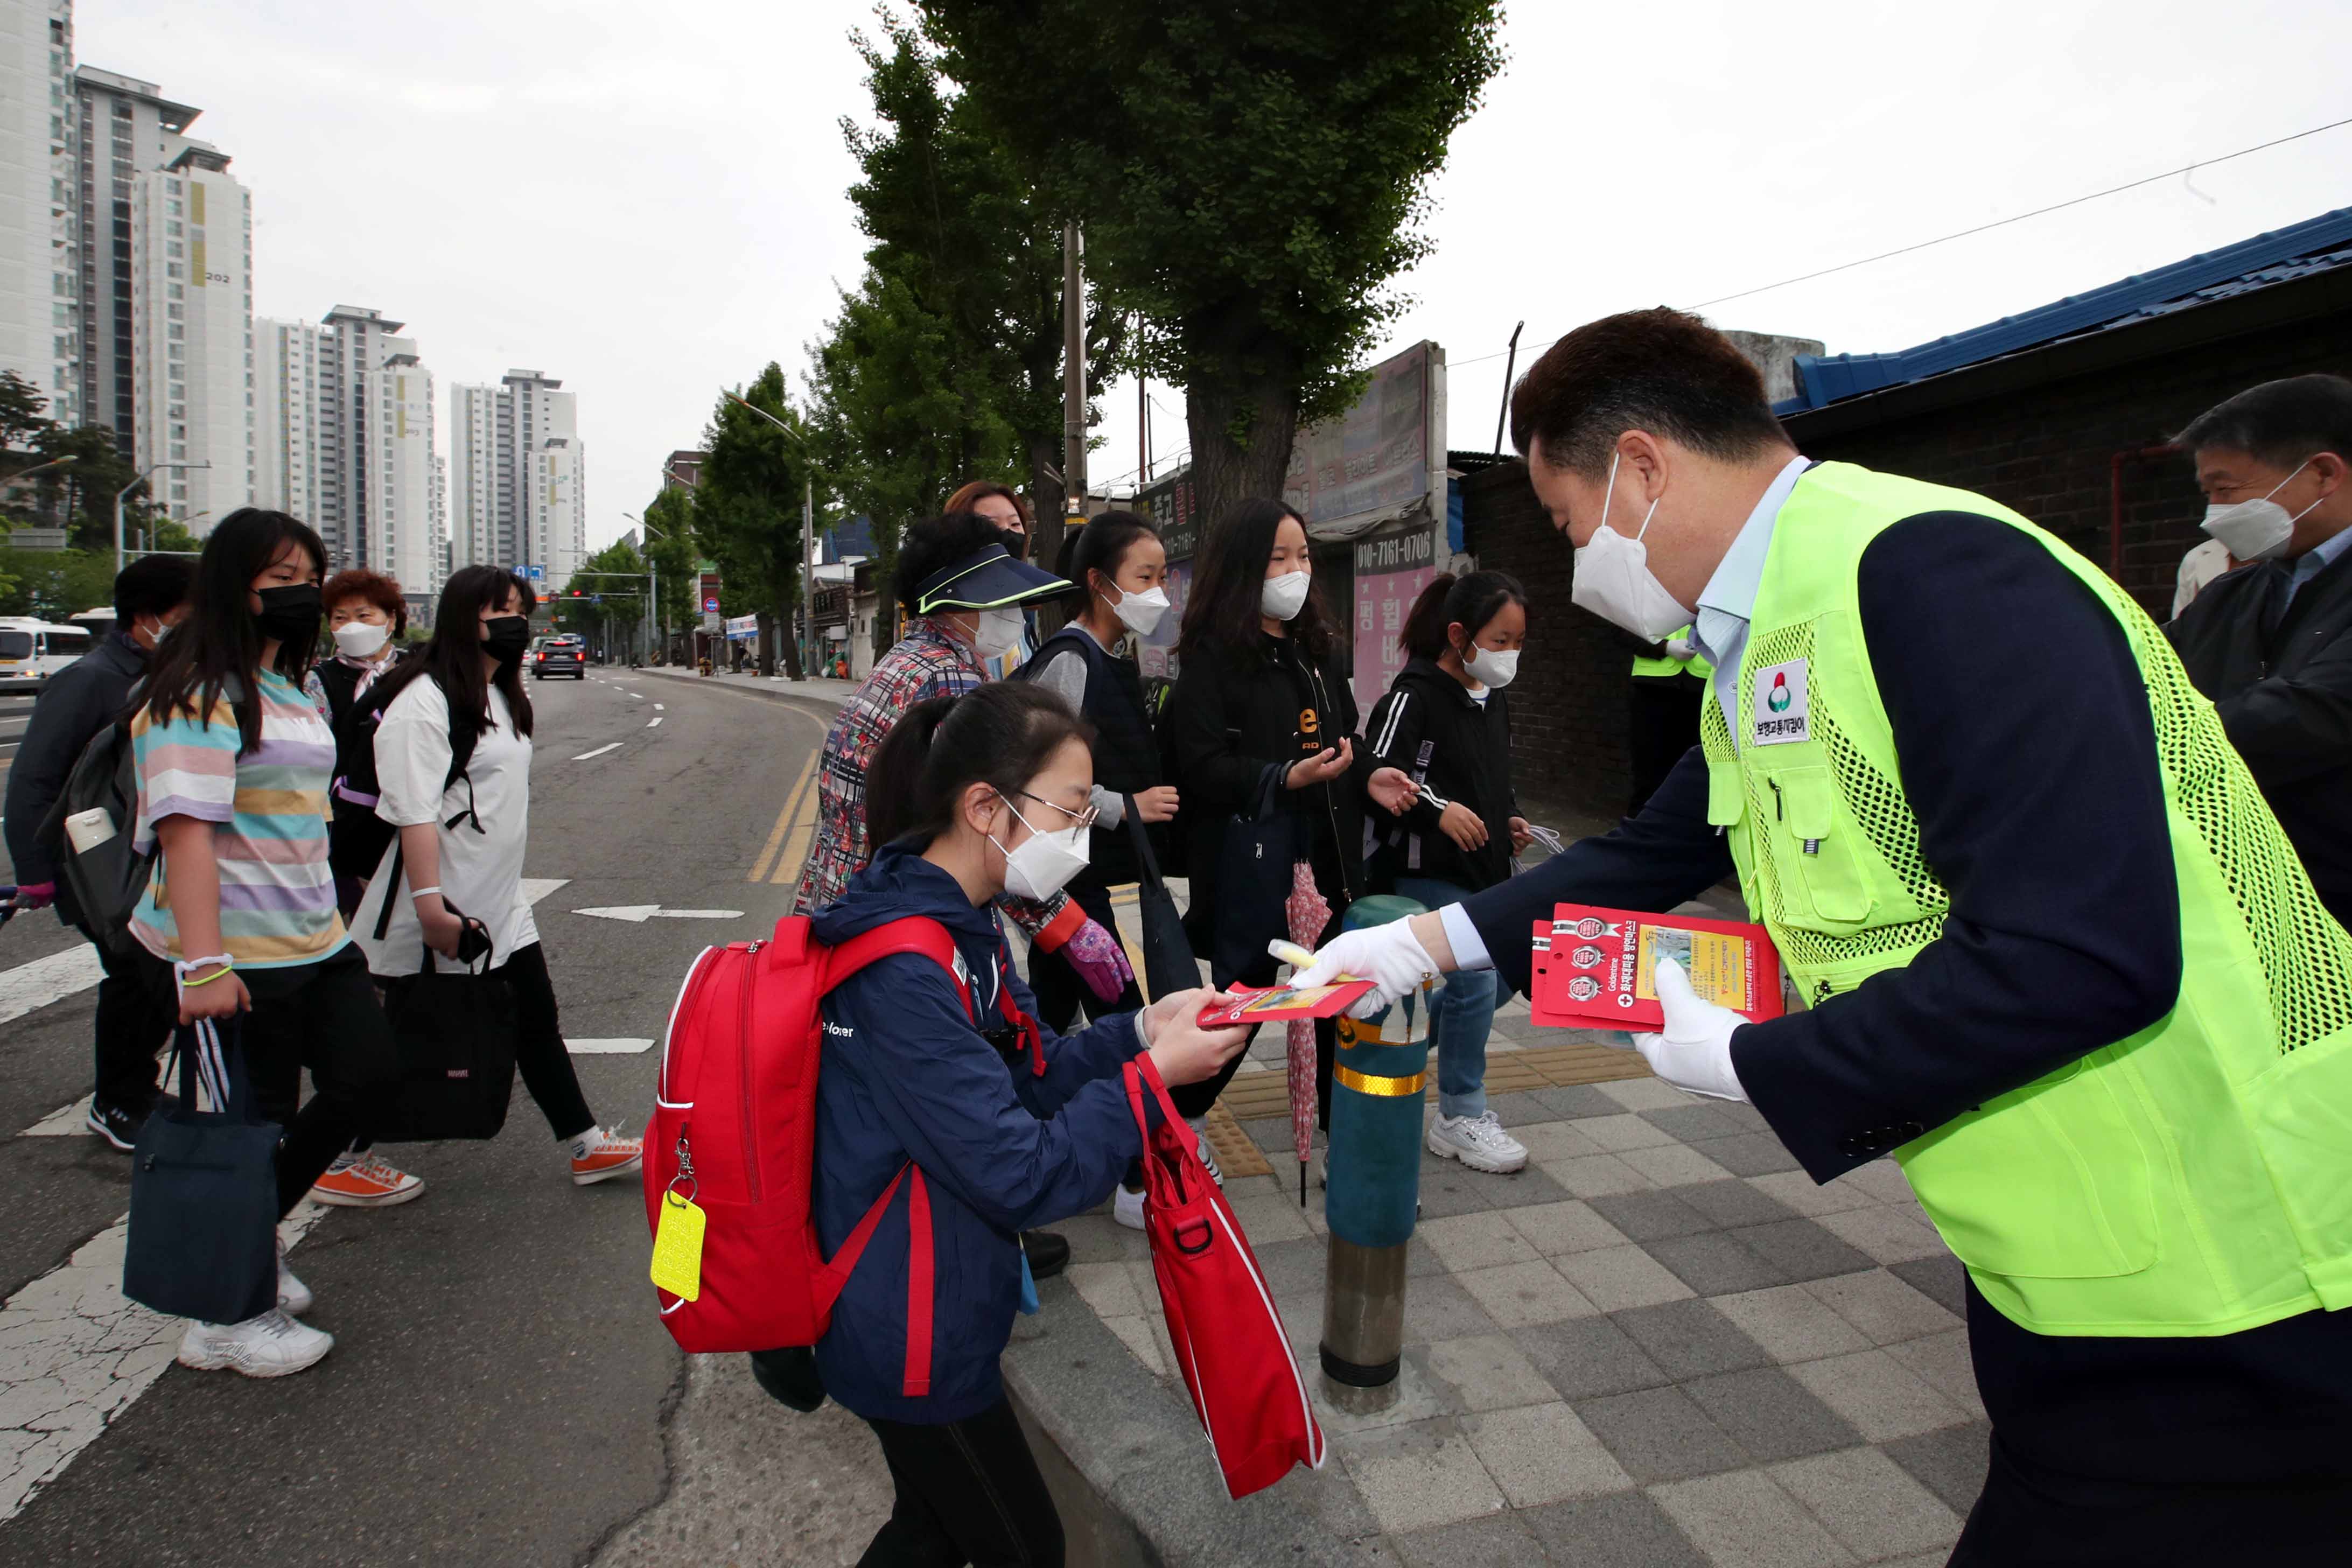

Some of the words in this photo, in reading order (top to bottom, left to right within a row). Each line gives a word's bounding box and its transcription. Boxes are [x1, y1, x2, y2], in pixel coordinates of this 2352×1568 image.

[205, 272, 230, 283] 202
[1154, 493, 1174, 532] 중고
[1358, 530, 1430, 568] 010-7161-0706
[1756, 716, 1805, 737] 보행교통지킴이
[1622, 920, 1636, 952] 방연마스크
[1607, 957, 1619, 992] Goldentime
[1621, 953, 1635, 992] 화재대피용
